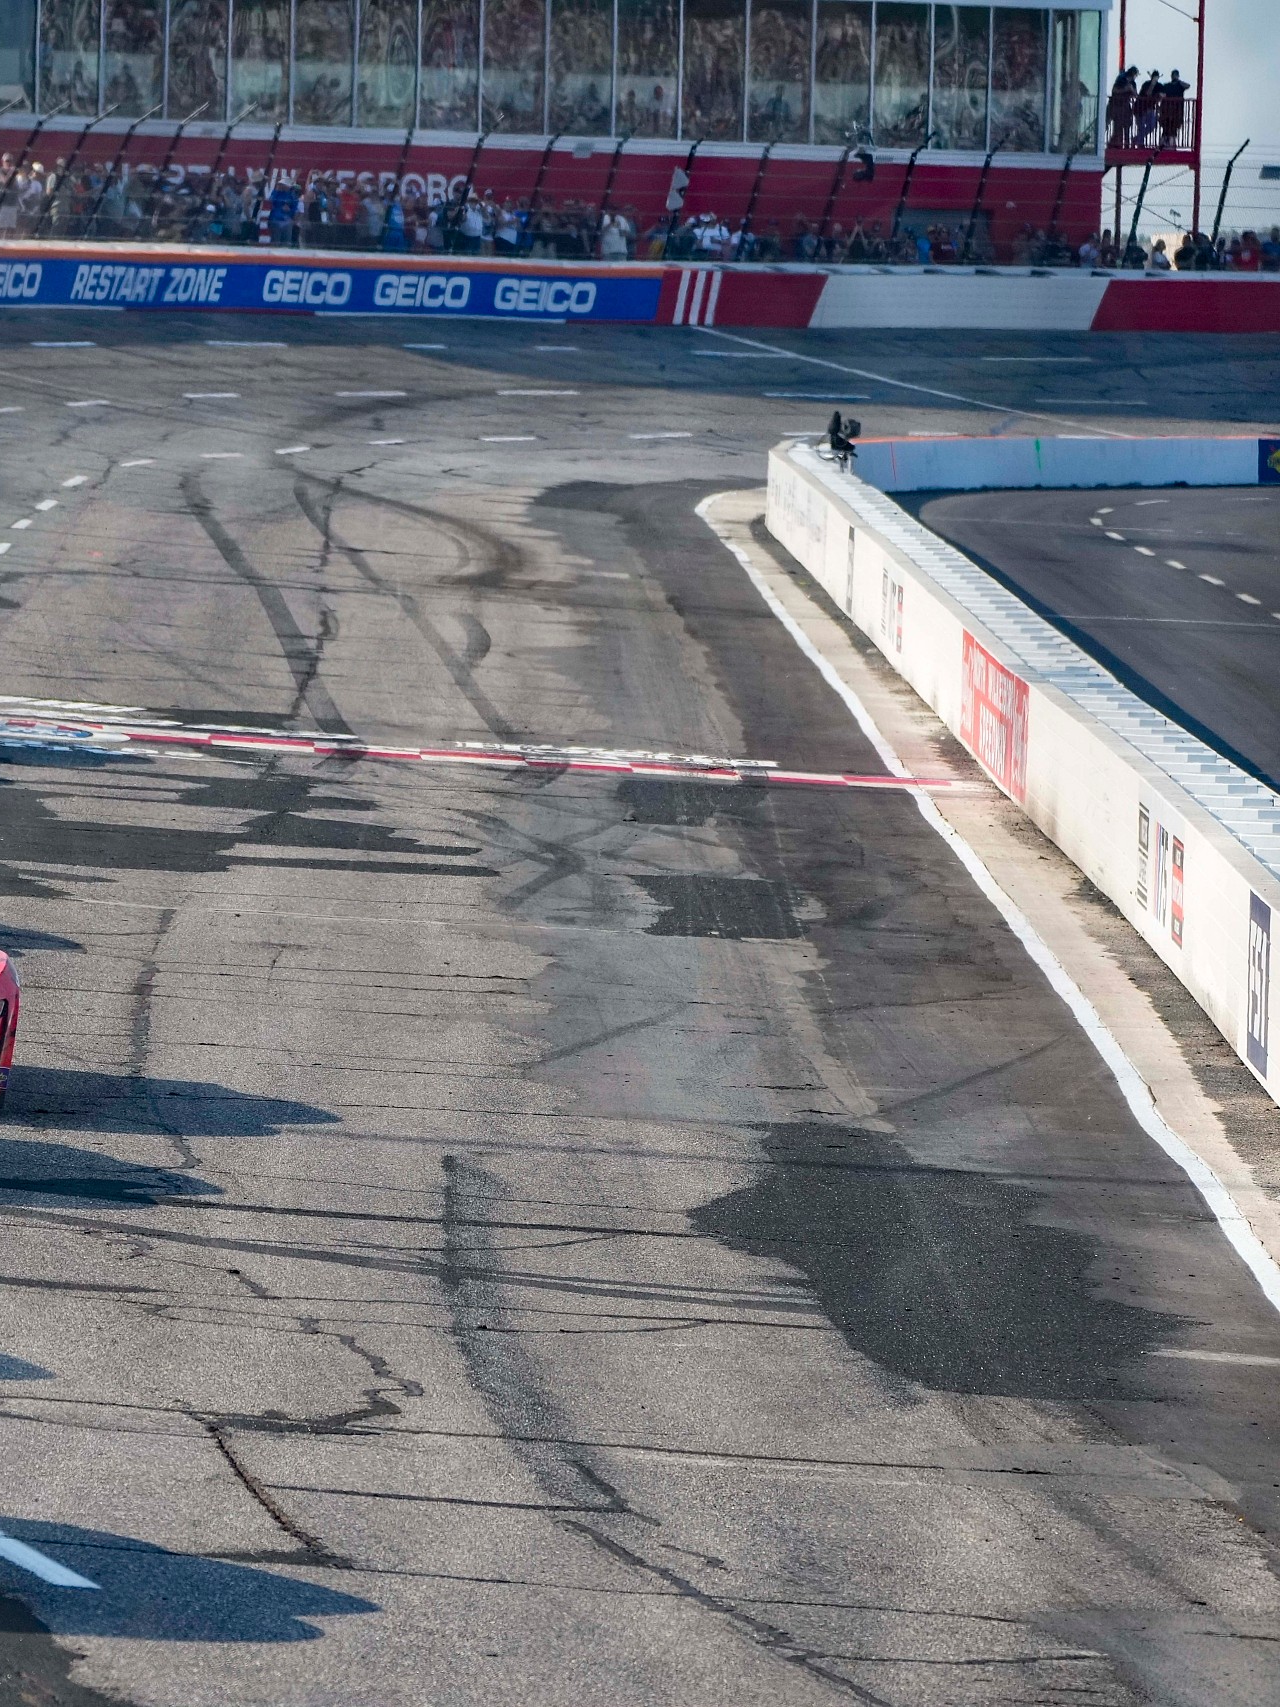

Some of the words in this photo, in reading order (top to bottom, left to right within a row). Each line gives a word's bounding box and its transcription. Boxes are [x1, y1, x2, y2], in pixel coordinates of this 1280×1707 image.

[70, 264, 165, 301] RESTART
[164, 268, 228, 302] ZONE
[263, 270, 352, 305] GEICO
[374, 275, 471, 308] GEICO
[494, 278, 597, 313] GEICO
